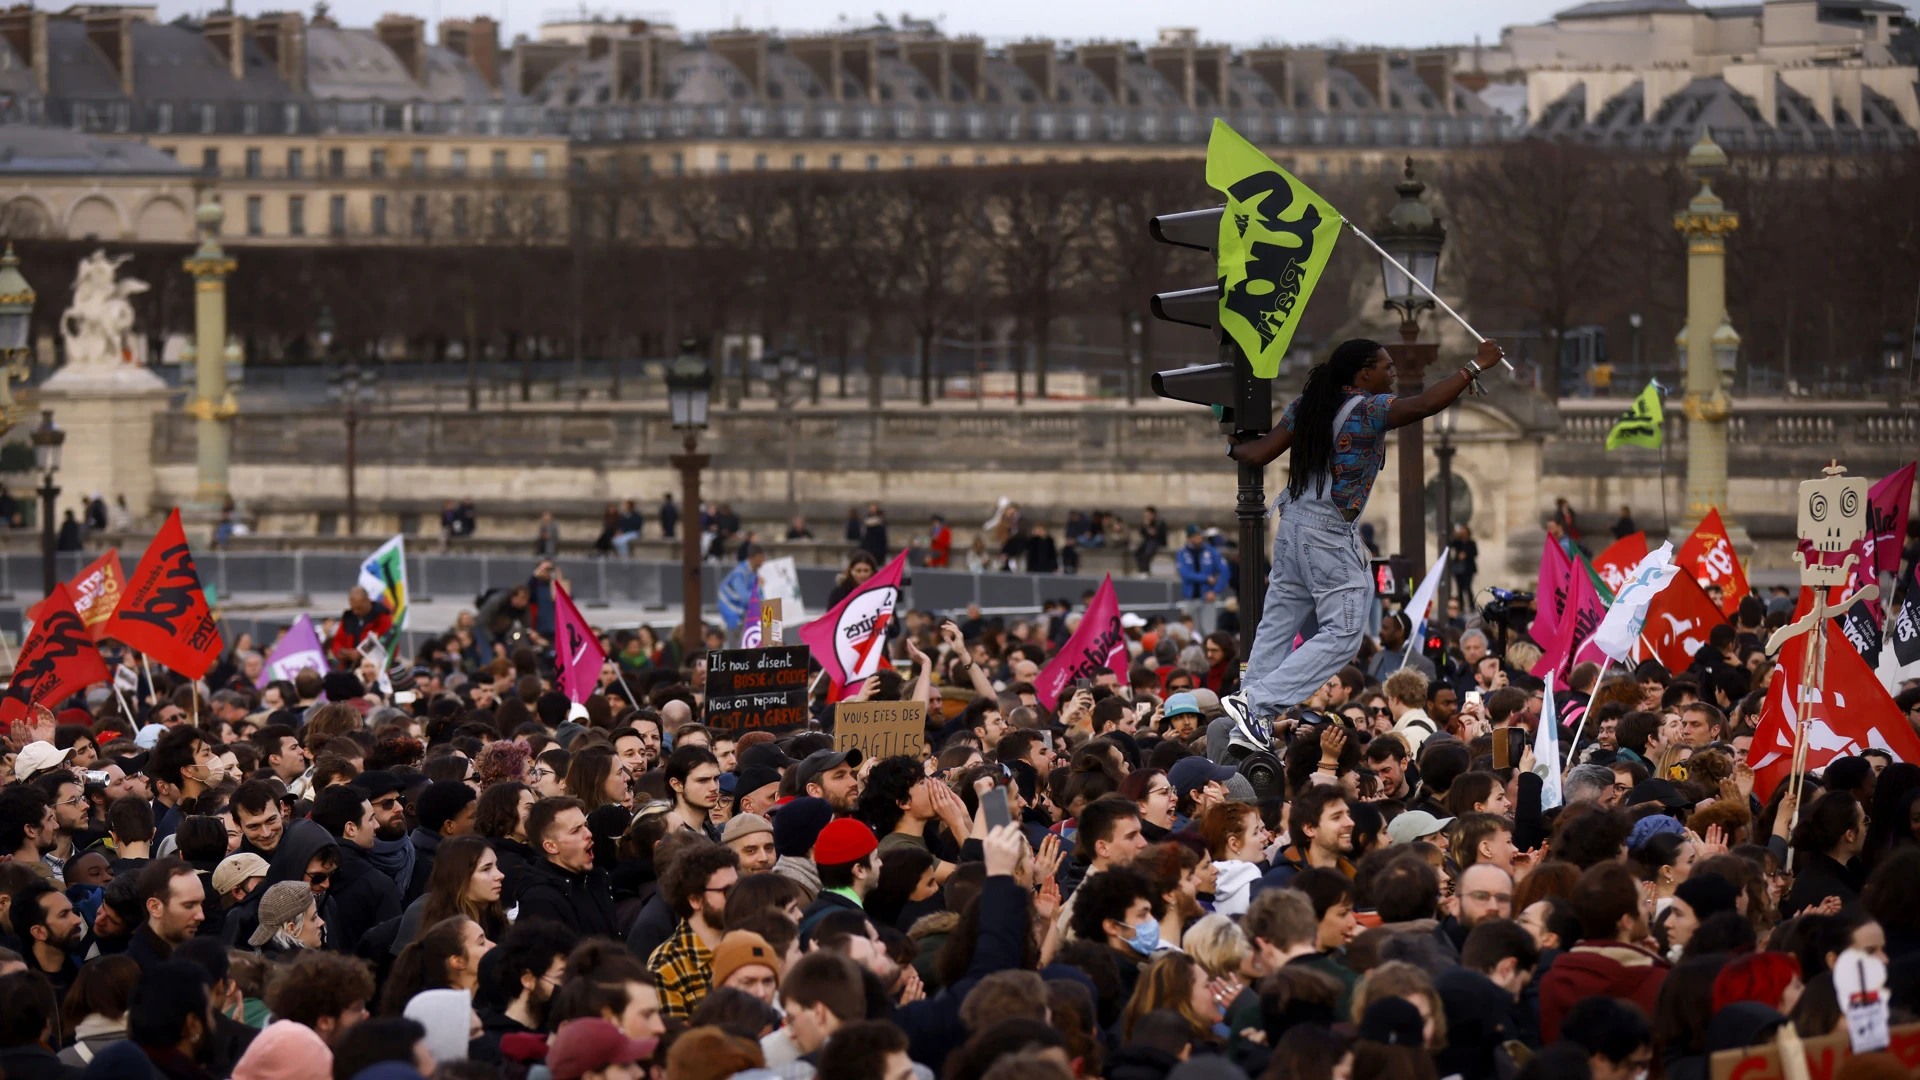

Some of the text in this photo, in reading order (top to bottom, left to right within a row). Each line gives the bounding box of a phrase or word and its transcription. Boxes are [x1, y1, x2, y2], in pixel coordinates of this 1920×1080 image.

[710, 652, 792, 672] Ils nous disent
[709, 699, 732, 712] Nous
[734, 698, 748, 708] on
[744, 711, 761, 728] LA
[843, 711, 869, 724] VOUS
[902, 708, 920, 721] DES
